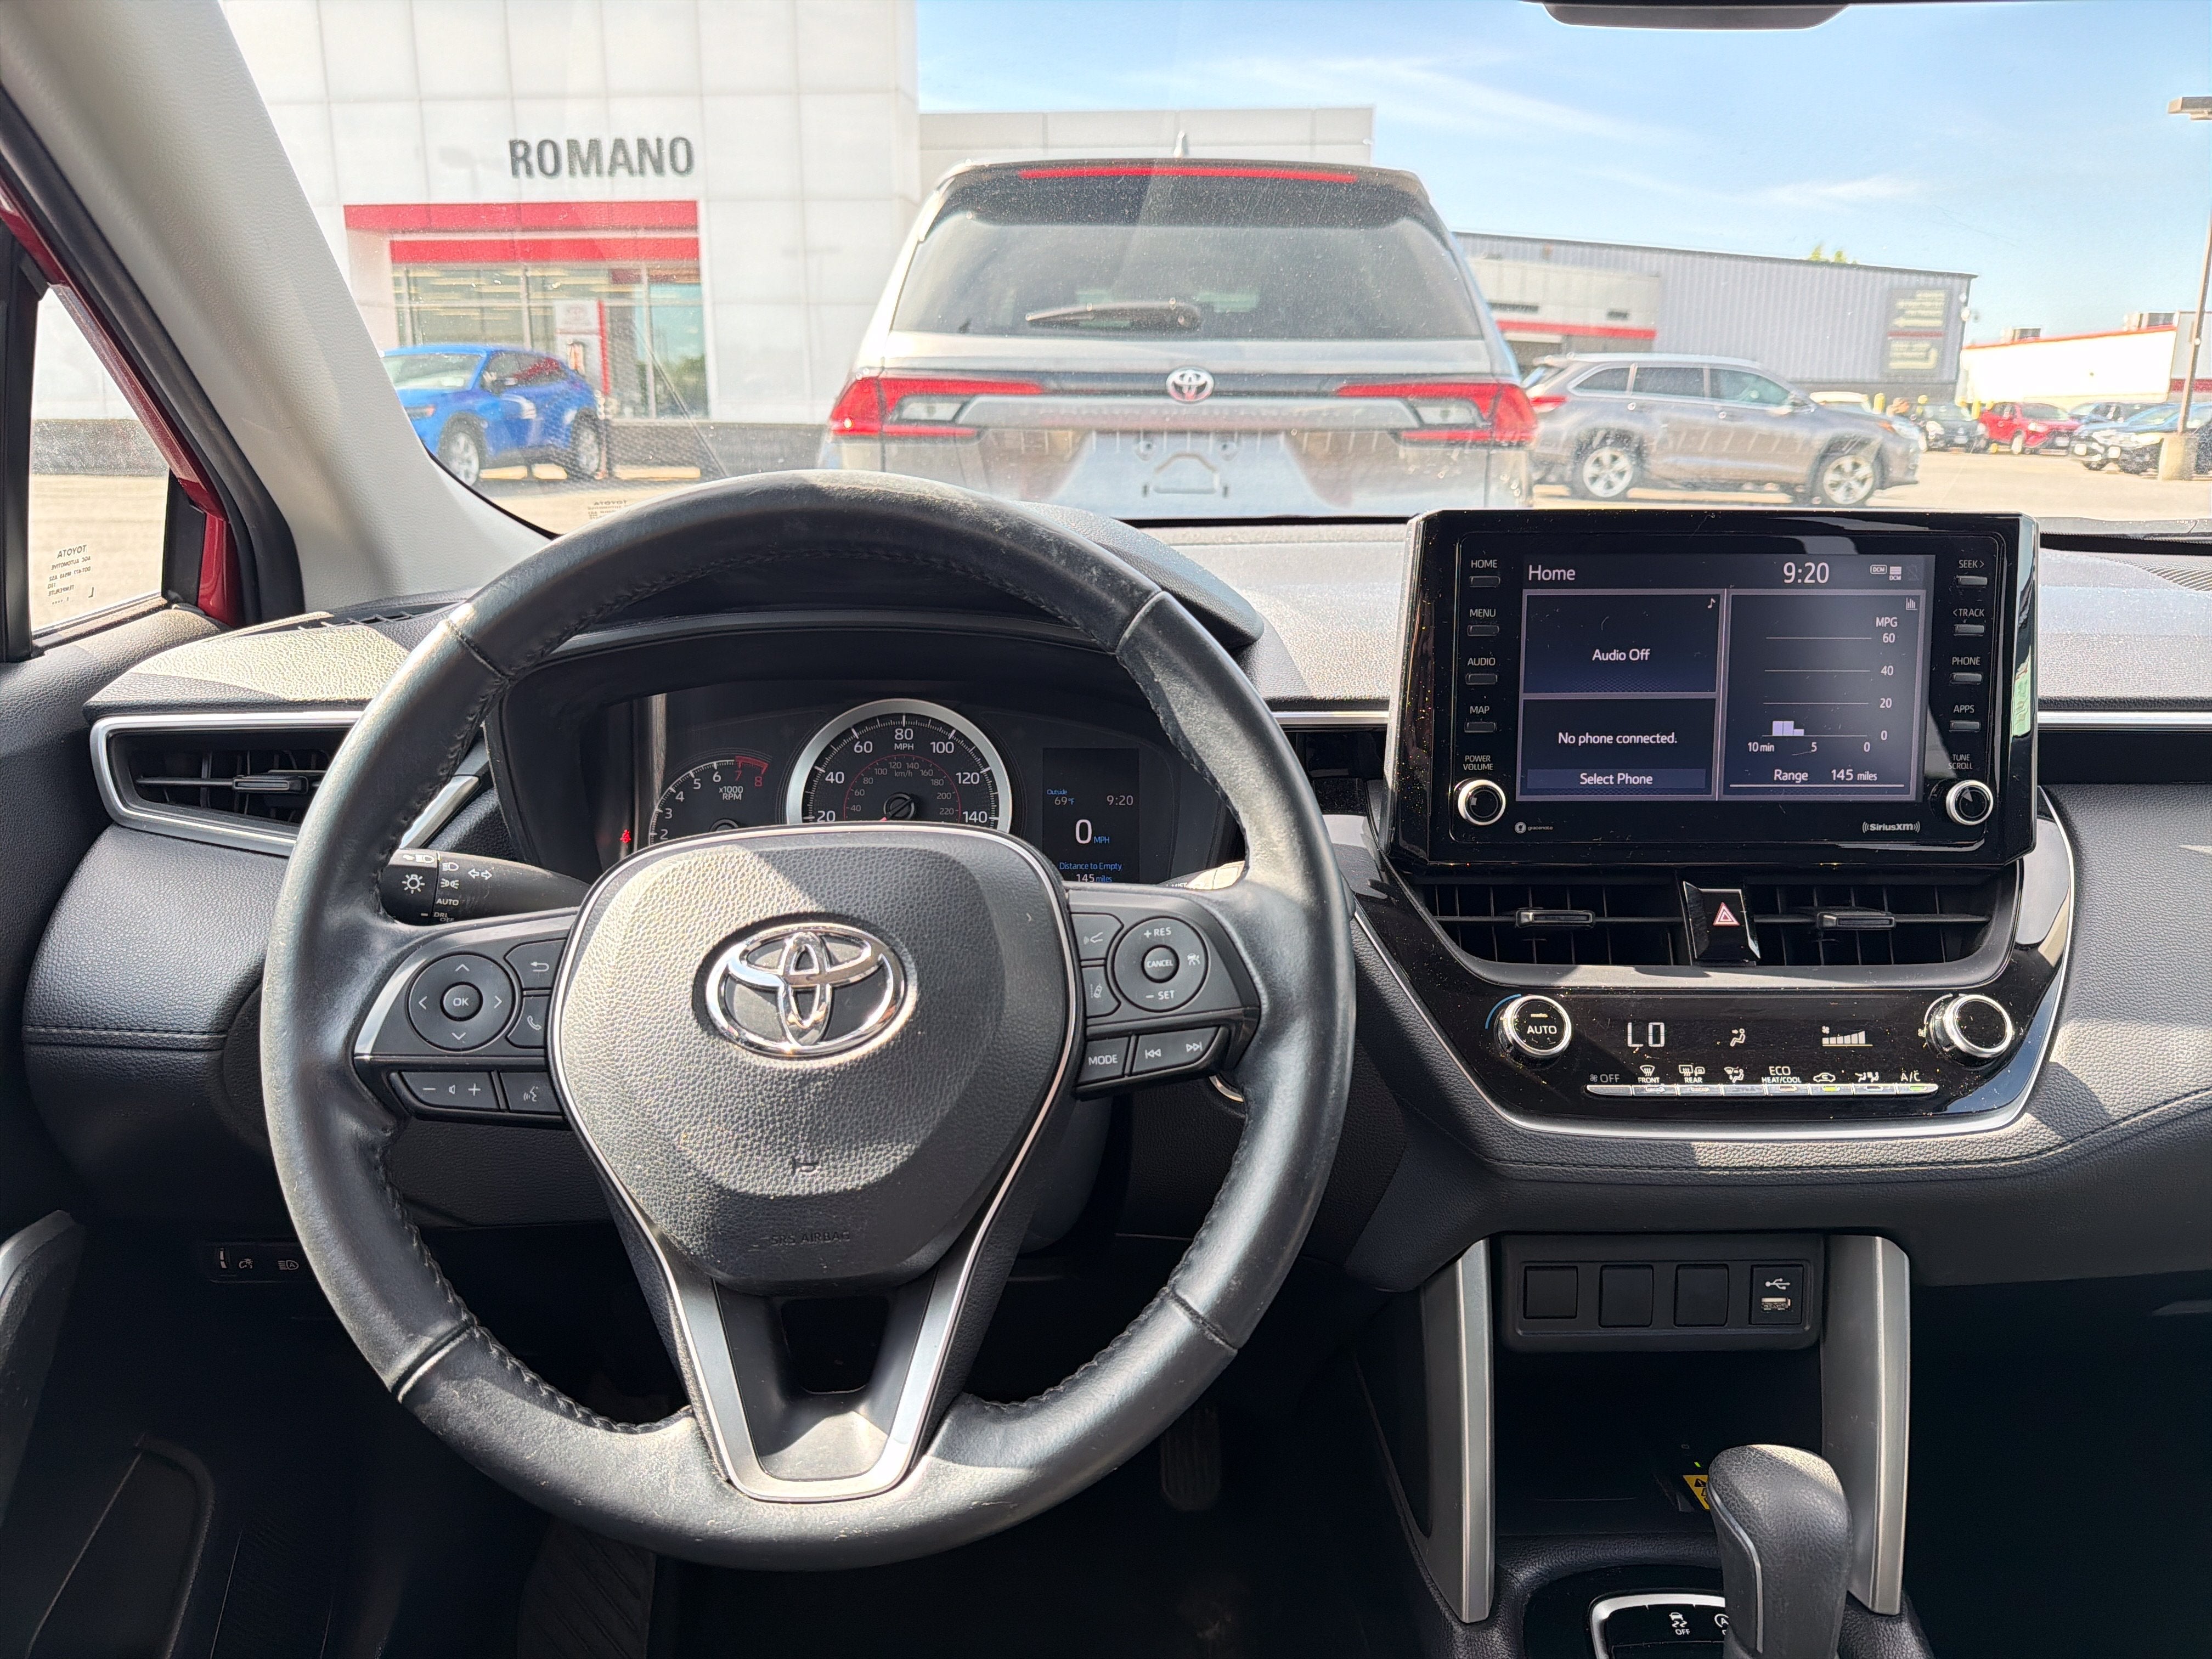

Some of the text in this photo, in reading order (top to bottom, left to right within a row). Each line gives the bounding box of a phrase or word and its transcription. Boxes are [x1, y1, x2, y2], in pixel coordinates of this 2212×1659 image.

[509, 137, 695, 179] ROMANO
[1470, 559, 1498, 568] HOME
[1528, 565, 1576, 580] Home
[1783, 562, 1830, 583] 9:20
[1469, 608, 1496, 617] MENU
[1875, 617, 1898, 628] MPG
[1882, 633, 1895, 643] 60
[1592, 648, 1651, 661] Audio Off
[1467, 657, 1496, 666] AUDIO
[1951, 656, 1980, 665] PHONE
[1881, 665, 1894, 676] 40
[1880, 698, 1892, 708] 20
[1953, 704, 1974, 713] APPS
[1470, 706, 1490, 714] MAP
[894, 728, 913, 741] 80
[1558, 731, 1678, 746] No phone connected.
[1881, 730, 1887, 741] 0
[854, 741, 873, 753] 60
[930, 741, 955, 754] 100
[1748, 742, 1775, 752] 10 min
[1810, 742, 1817, 752] 5
[1864, 742, 1870, 752] 0
[713, 771, 721, 782] 6
[735, 770, 742, 781] 7
[825, 771, 844, 784] 40
[956, 772, 980, 785] 120
[1579, 772, 1653, 785] Select Phone
[1774, 769, 1877, 783] Range 145 miles
[693, 778, 701, 789] 5
[754, 776, 763, 787] 8
[675, 791, 685, 802] 4
[1107, 795, 1133, 806] 9:20
[664, 808, 673, 819] 3
[817, 810, 836, 822] 20
[962, 811, 988, 823] 140
[660, 829, 668, 840] 2
[1075, 819, 1092, 844] 0
[1059, 862, 1089, 870] Distance
[1099, 862, 1122, 871] Empty
[1076, 873, 1112, 883] 145 miles
[453, 997, 469, 1006] OK
[1527, 1025, 1557, 1034] AUTO
[1088, 1054, 1118, 1065] MODE
[1769, 1066, 1791, 1075] ECO
[1600, 1074, 1620, 1082] OFF
[1900, 1072, 1920, 1082] A/C
[771, 1232, 850, 1246] SRS AIRBAG
